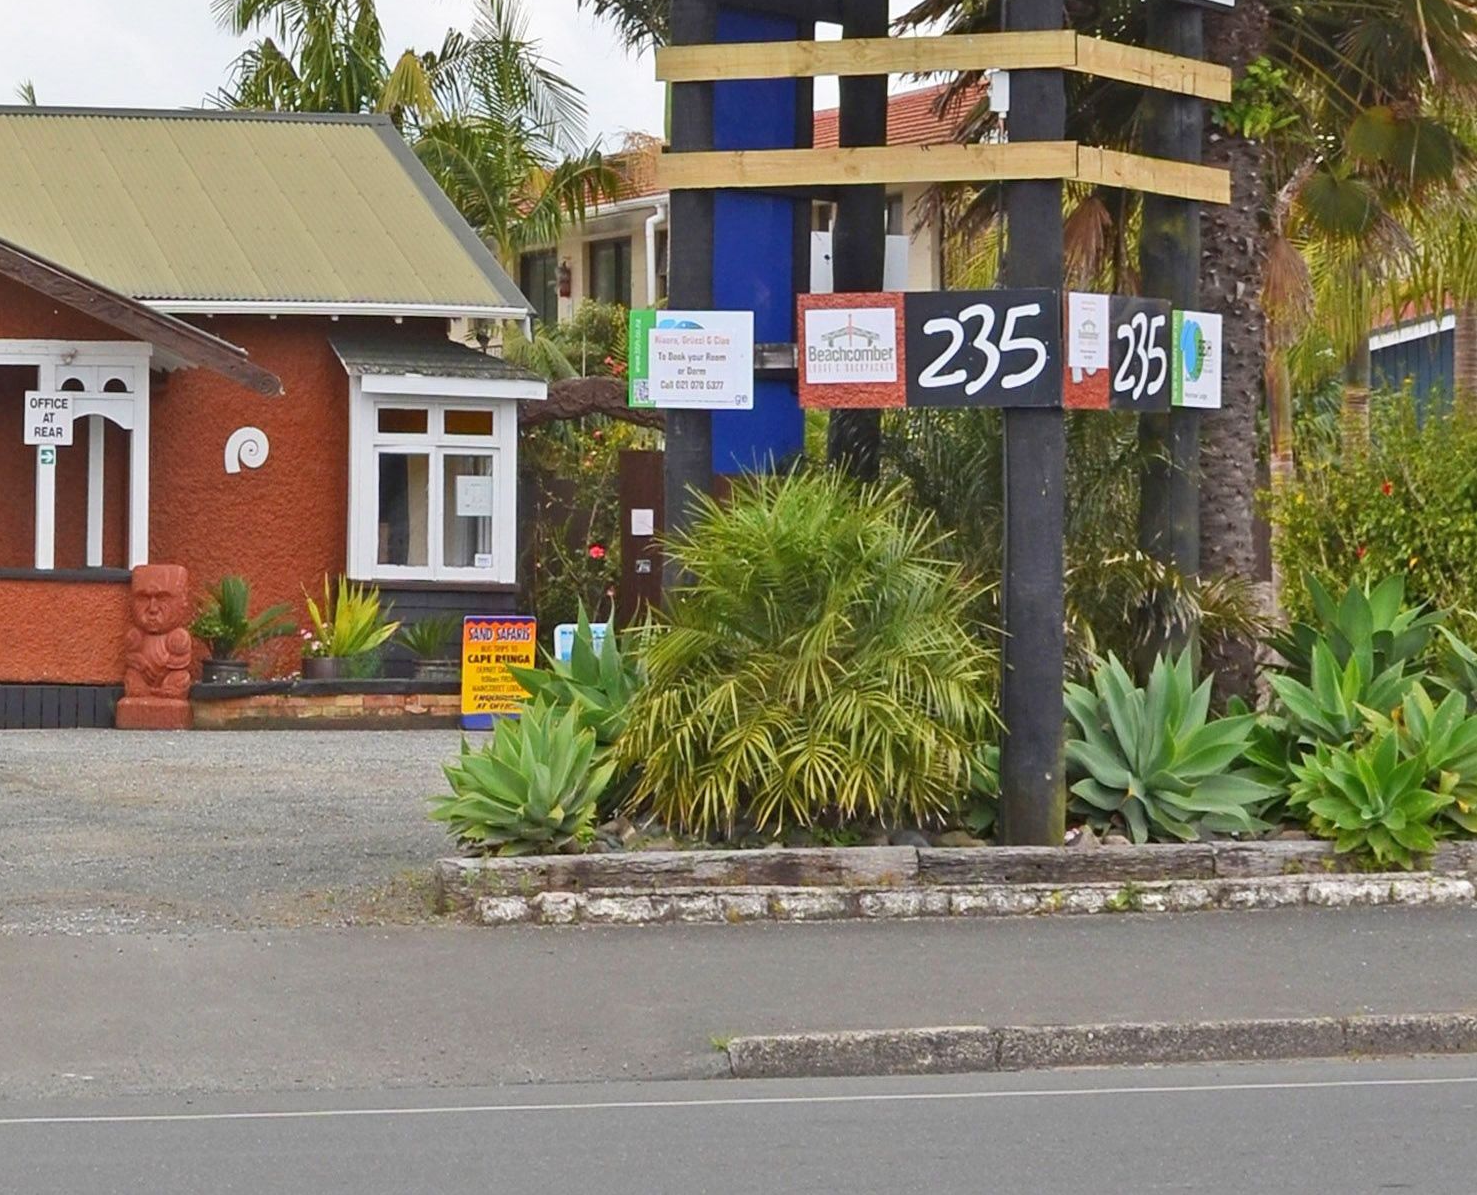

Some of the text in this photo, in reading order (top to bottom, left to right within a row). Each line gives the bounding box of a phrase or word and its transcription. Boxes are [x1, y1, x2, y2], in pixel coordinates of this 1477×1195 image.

[807, 345, 894, 363] Beachcomber
[918, 303, 1047, 395] 235
[658, 351, 727, 362] To Book your Room
[1114, 312, 1168, 401] 235
[677, 366, 706, 376] or Dorm
[660, 380, 674, 390] Call
[29, 397, 69, 410] OFFICE
[42, 412, 55, 423] AT
[34, 427, 63, 438] REAR
[468, 627, 531, 641] SAND SAFARIS
[467, 654, 531, 664] CAPE REINGA
